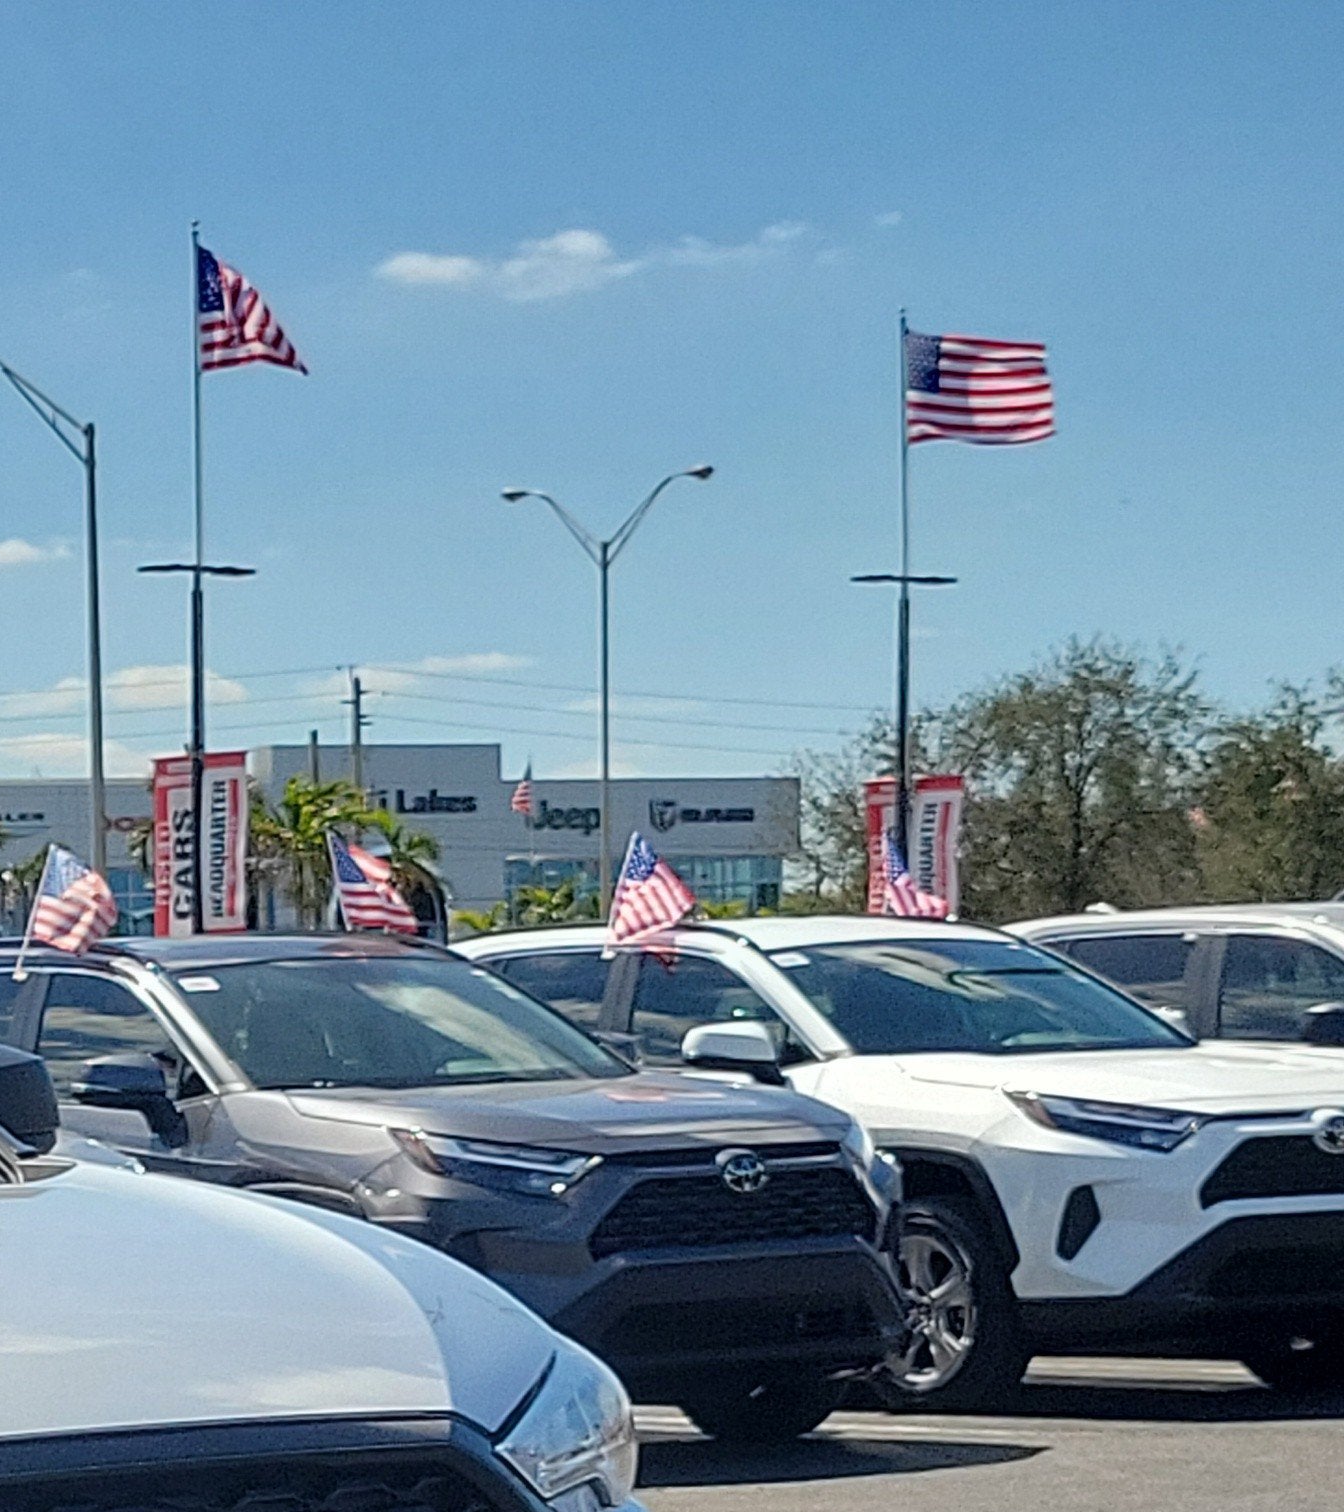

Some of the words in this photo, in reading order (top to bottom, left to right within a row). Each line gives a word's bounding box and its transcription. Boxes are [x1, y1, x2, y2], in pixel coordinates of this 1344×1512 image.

[396, 789, 478, 814] Lakes
[532, 800, 600, 835] Jeep
[173, 808, 195, 920] CARS
[209, 780, 228, 918] HEADQUARTER
